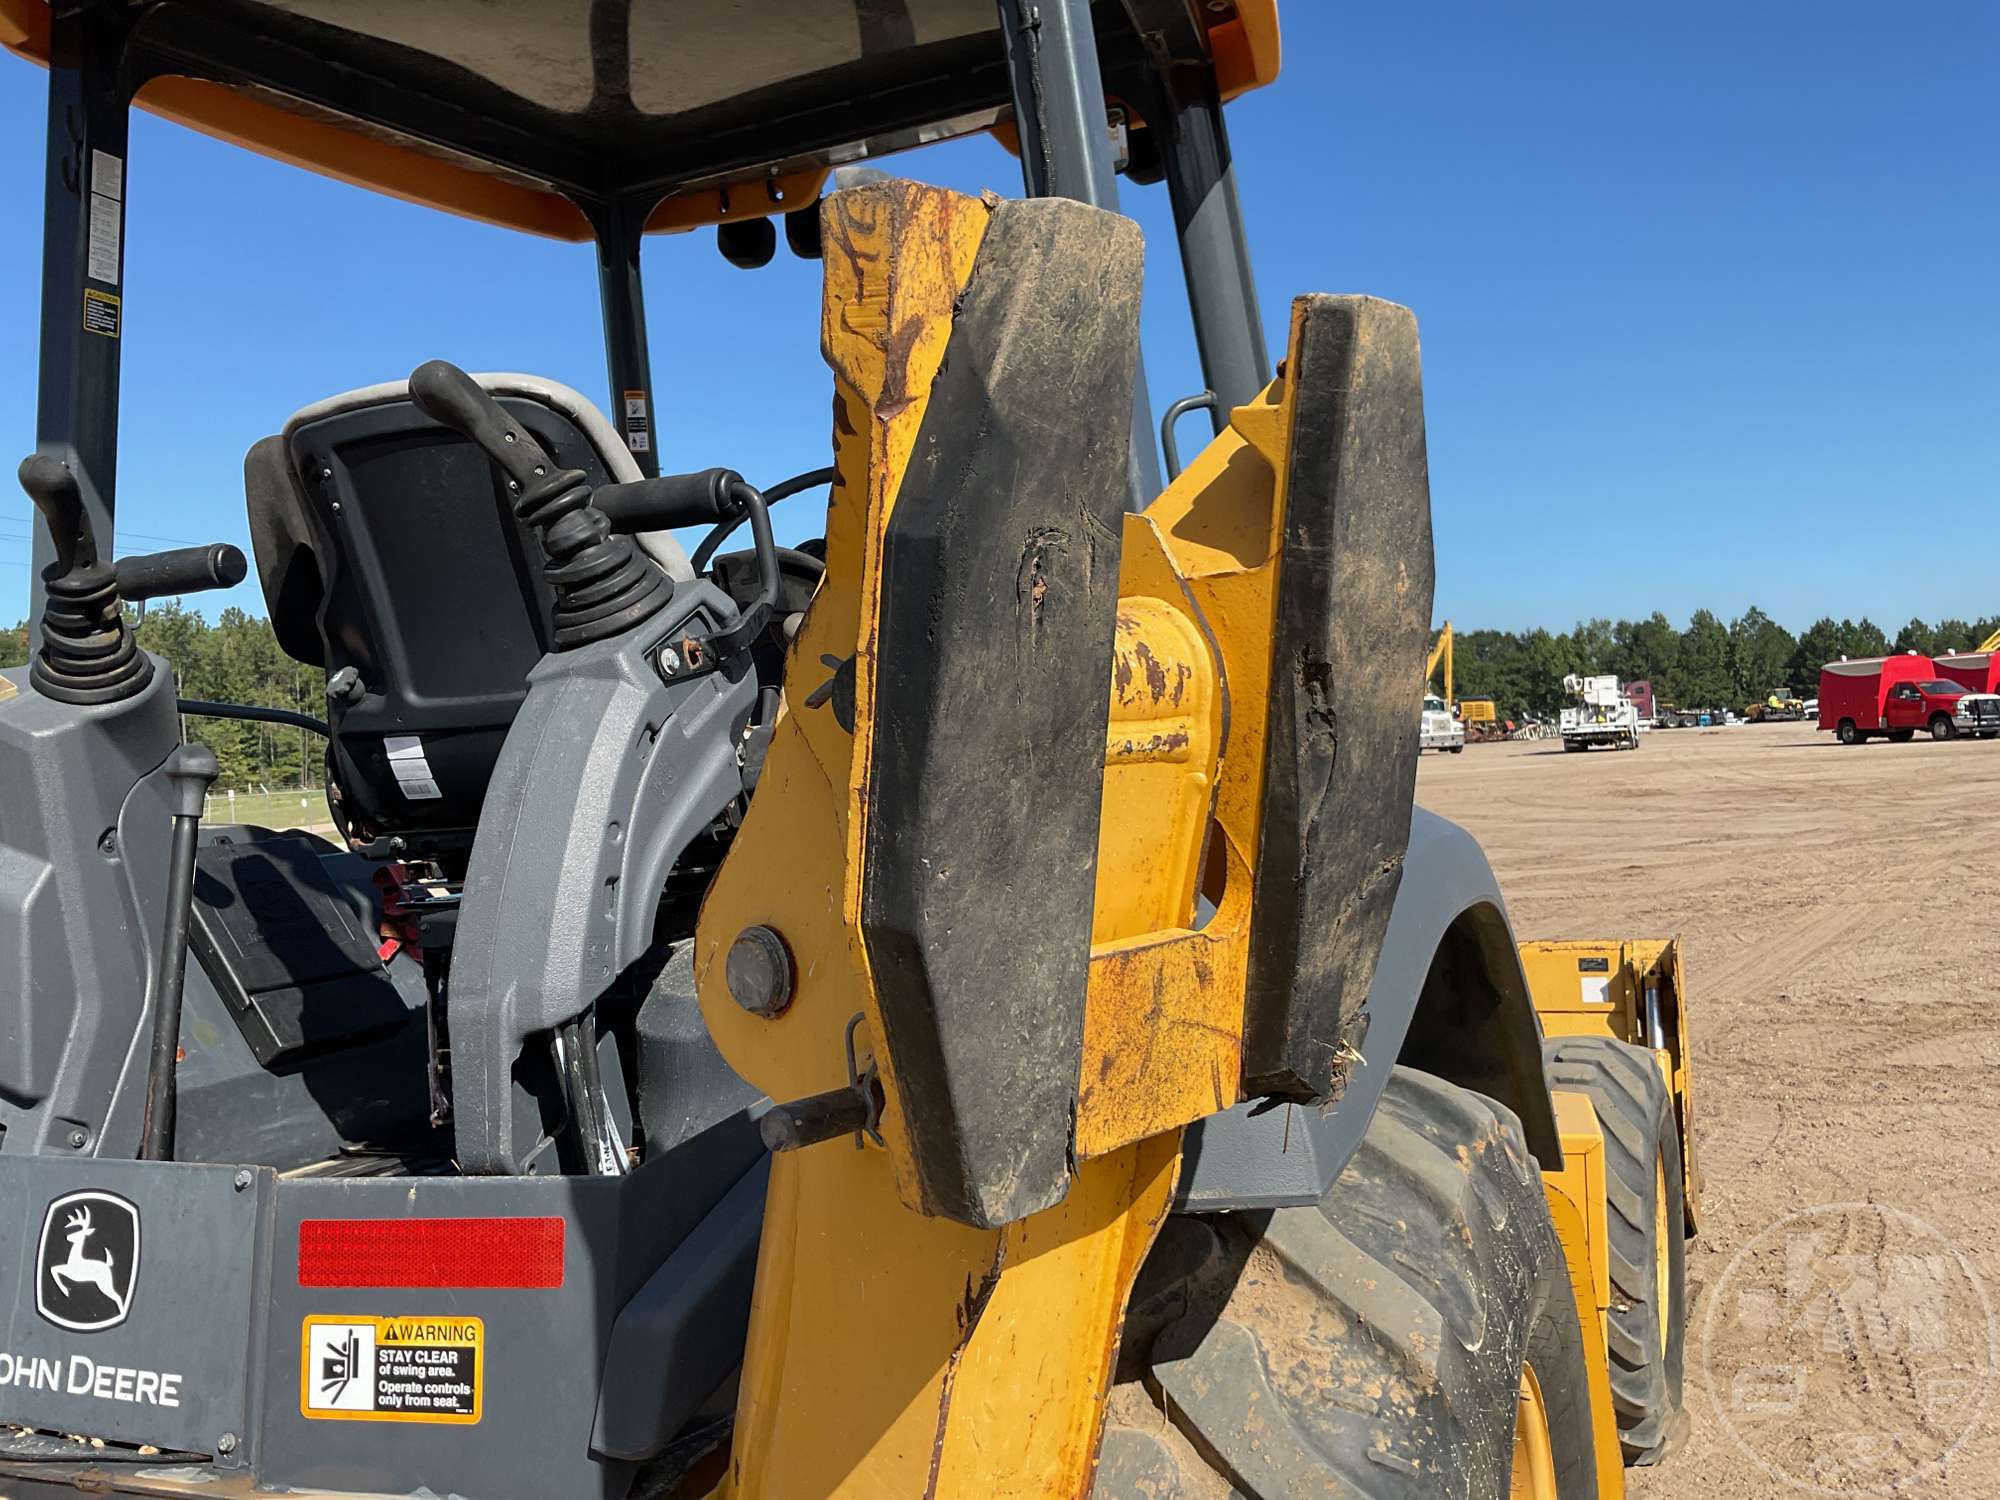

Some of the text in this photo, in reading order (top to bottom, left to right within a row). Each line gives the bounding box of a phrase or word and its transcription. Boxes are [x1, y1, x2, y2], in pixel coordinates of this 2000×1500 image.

[399, 1325, 476, 1342] WARNING
[378, 1350, 458, 1365] STAY CLEAR
[378, 1363, 456, 1378] of swing area.
[0, 1353, 183, 1408] OHN DEERE
[378, 1380, 471, 1396] Operate controls
[377, 1394, 460, 1408] only from seat.
